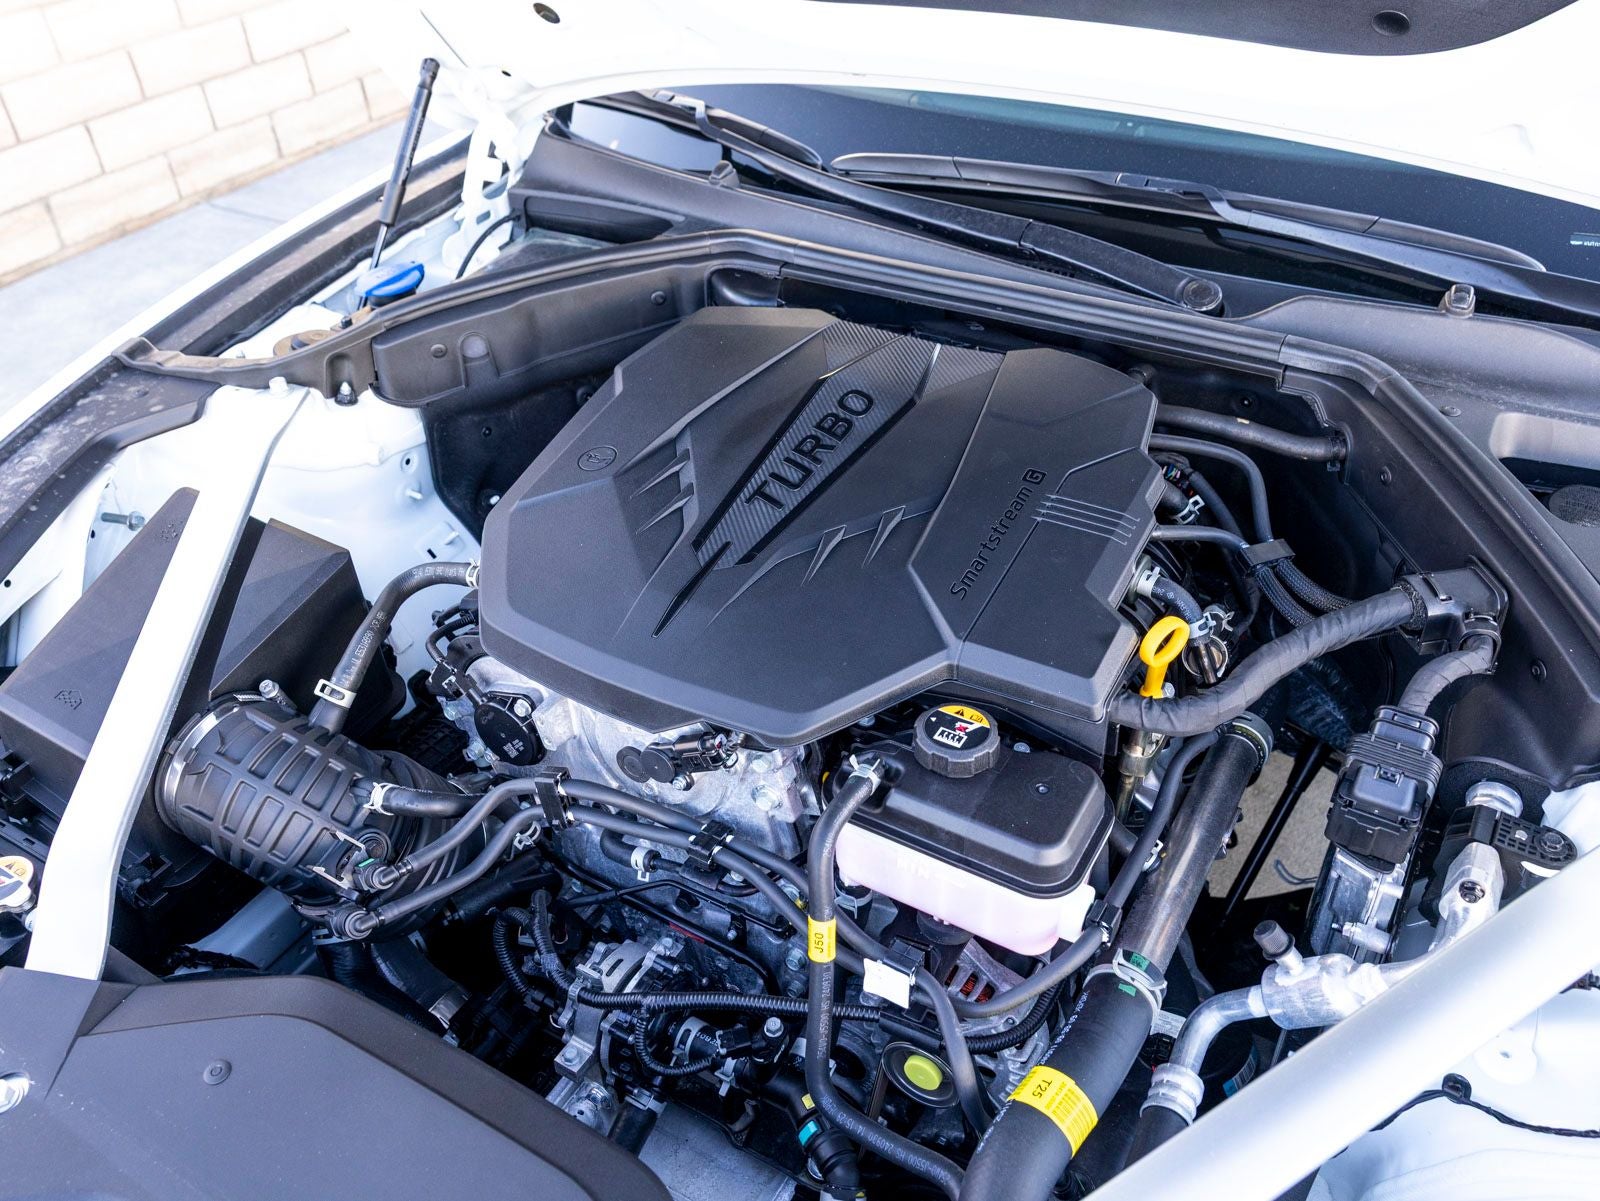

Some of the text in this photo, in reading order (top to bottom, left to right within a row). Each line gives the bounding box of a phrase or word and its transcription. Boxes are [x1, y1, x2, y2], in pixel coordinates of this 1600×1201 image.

[744, 389, 874, 511] TURBO
[950, 486, 1033, 600] Smartstream
[813, 932, 824, 954] J50
[1031, 1079, 1053, 1098] T25
